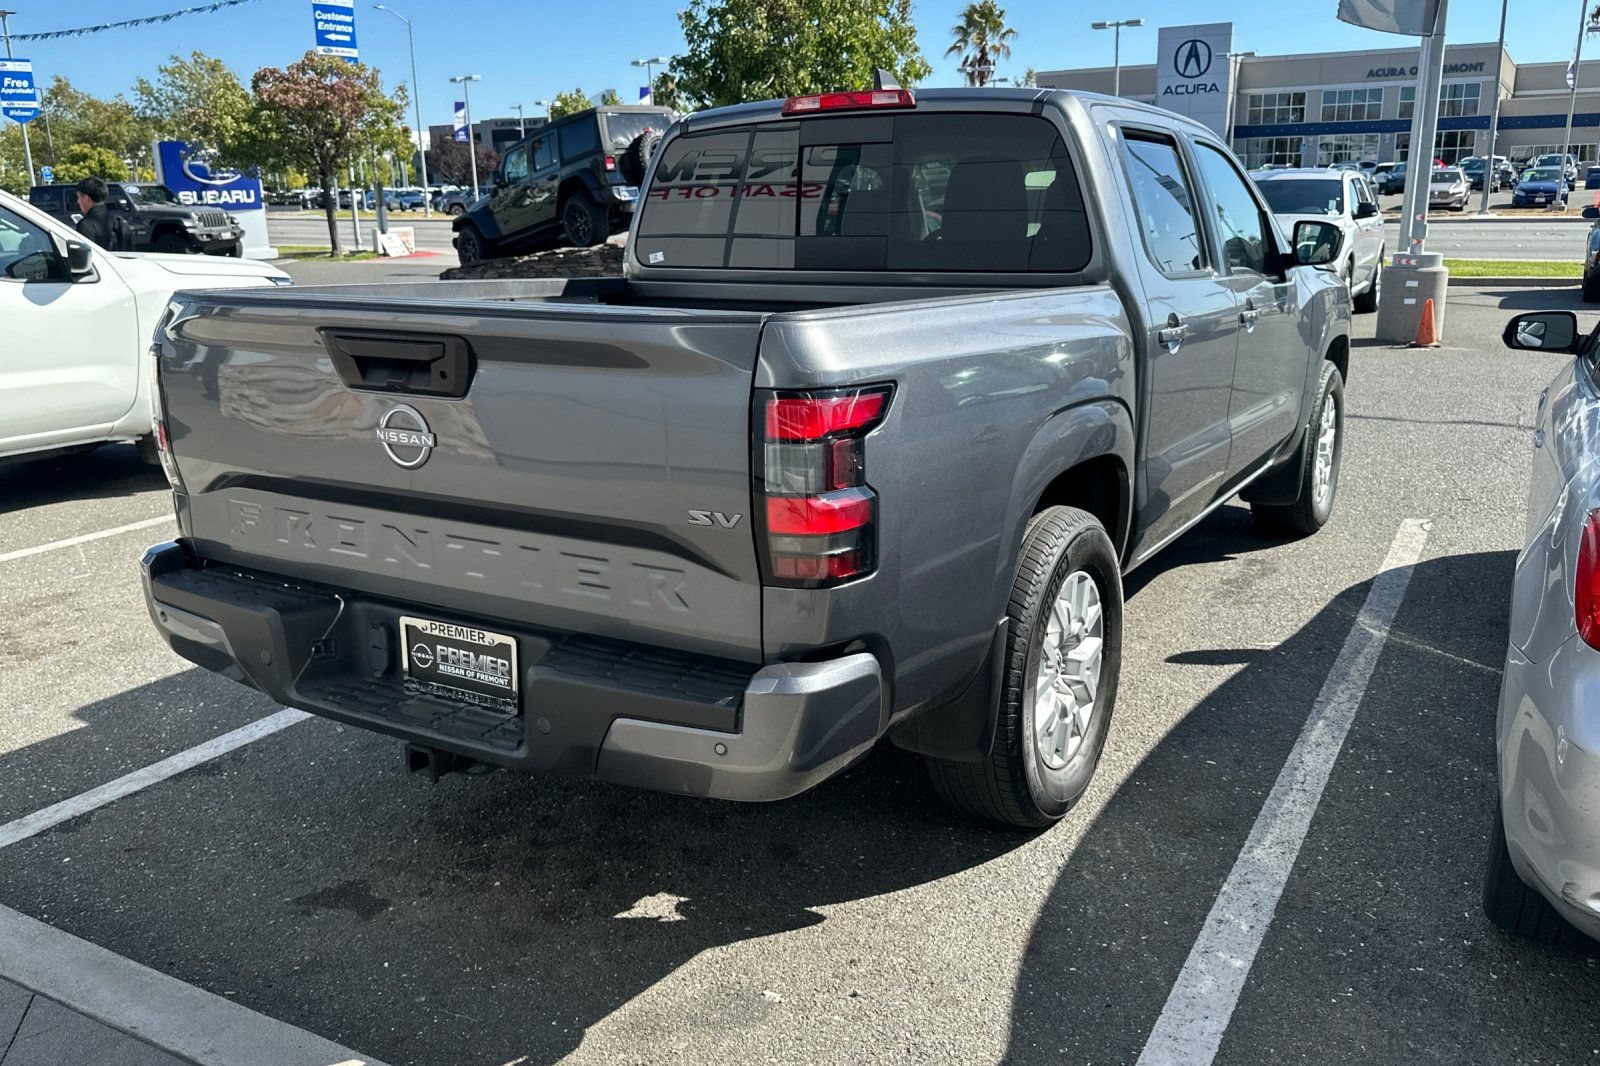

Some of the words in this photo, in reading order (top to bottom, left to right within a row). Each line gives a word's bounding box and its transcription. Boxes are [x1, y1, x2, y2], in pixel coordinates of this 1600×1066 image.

[315, 10, 354, 22] Customer
[317, 21, 353, 33] Entrance
[1366, 67, 1406, 78] ACURA
[1409, 66, 1419, 76] O
[1442, 62, 1486, 74] EMONT
[4, 77, 29, 88] Free
[1162, 82, 1220, 96] ACURA
[178, 189, 256, 205] SUBARU
[376, 428, 433, 446] NISSAN
[687, 509, 743, 529] SV
[226, 499, 692, 611] FRONTIER
[430, 622, 486, 642] PREMIER
[436, 644, 510, 677] PREMIER
[440, 664, 465, 676] NISSAN
[477, 672, 509, 686] FREMONT
